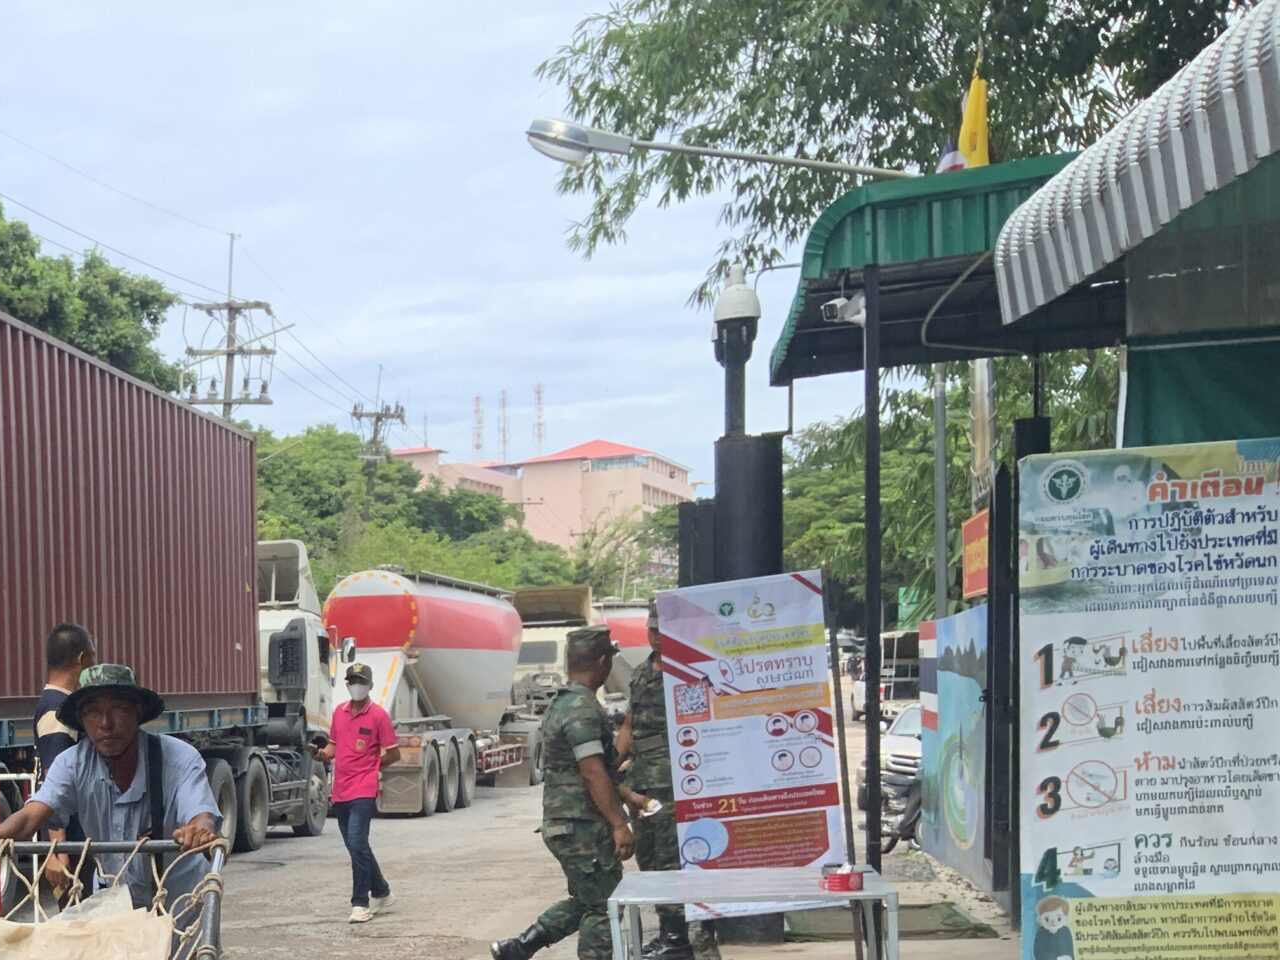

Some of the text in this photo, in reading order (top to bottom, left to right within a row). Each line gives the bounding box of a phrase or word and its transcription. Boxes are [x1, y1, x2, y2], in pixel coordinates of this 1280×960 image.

[1149, 468, 1265, 502] คำเตือน
[1128, 504, 1279, 531] การปฏิบัติตัวสำหรับ
[1090, 528, 1278, 560] ผู้เดินทางไปยังประเทศที่มี
[1070, 552, 1278, 579] การระบาดของโรคไข้หวัดนก
[1132, 627, 1280, 654] เลี่ยง ไปพื้นที่เลี้ยงสัตว์ปี
[736, 654, 813, 676] โปรดทราบ
[1034, 643, 1054, 690] 1
[1135, 687, 1278, 715] เลี่ยง การสัมผัสสัตว์ปีก
[1036, 711, 1061, 753] 2
[1134, 751, 1176, 773] ห้าม
[1161, 770, 1280, 789] มาปรุงอาหารโดยเด็ดขา
[718, 798, 738, 814] 21
[1036, 776, 1062, 820] 3
[1134, 832, 1173, 849] ควร
[1179, 834, 1219, 848] กินร้อน
[1035, 847, 1061, 890] 4
[1133, 851, 1170, 864] ล้างมือ
